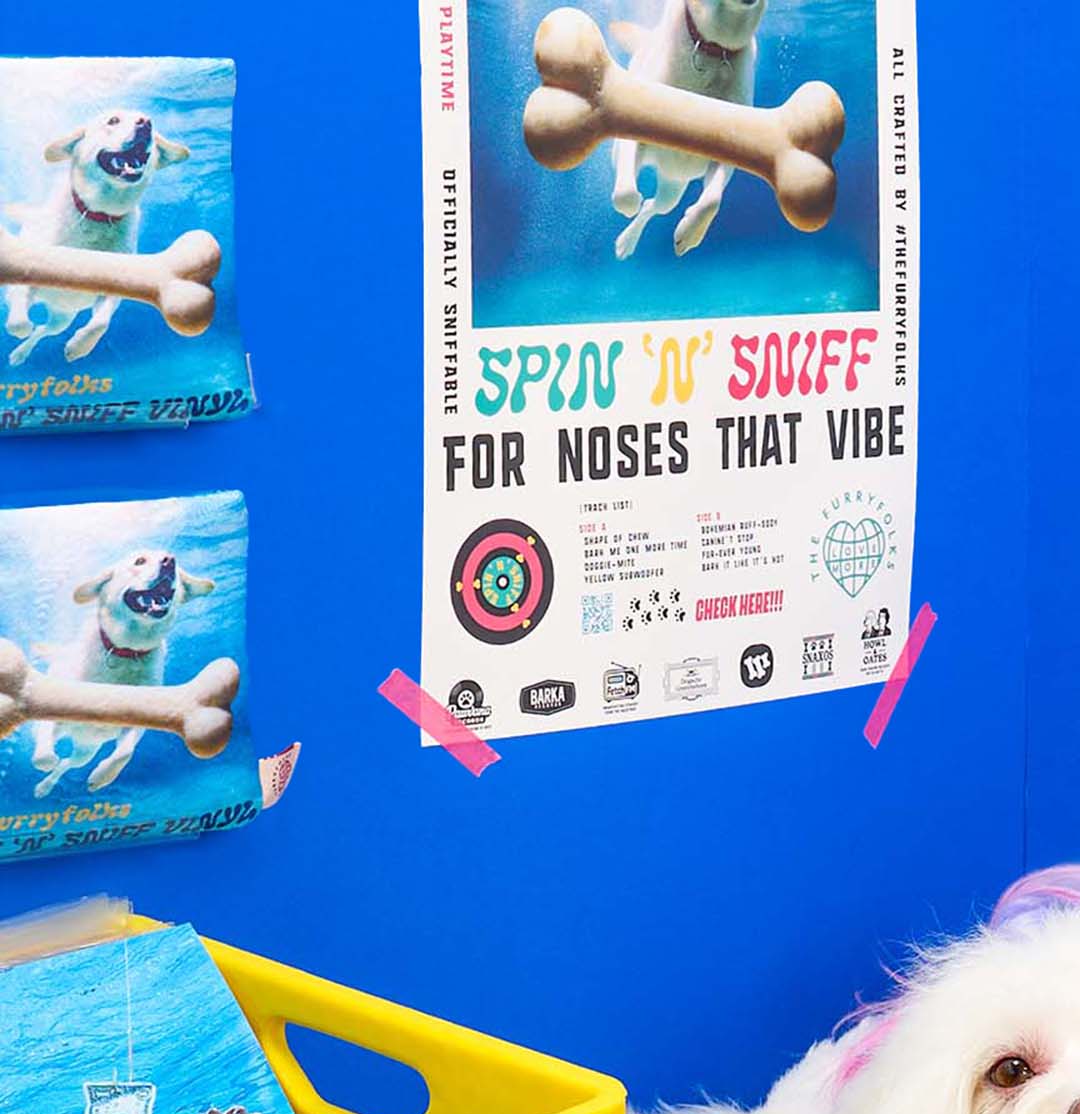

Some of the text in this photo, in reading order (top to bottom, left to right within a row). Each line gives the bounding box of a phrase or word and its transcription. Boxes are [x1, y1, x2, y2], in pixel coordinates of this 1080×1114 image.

[439, 5, 456, 113] PLAYTIME
[892, 47, 907, 388] ALL CRAFTED BY #THEFURRYFOLKS
[442, 169, 459, 417] OFFICIALLY SNIFFABLE
[474, 327, 879, 418] SPIN 'N' SNIFF
[443, 404, 906, 493] FOR NOSES THAT VIBE
[584, 531, 651, 547] SHAPE OF CHEW
[701, 523, 737, 536] BOHEMIAN
[737, 532, 755, 544] STOP
[809, 489, 899, 584] THE FURRYFOLKS
[584, 539, 689, 560] BARK ME ONE MORE TIME
[701, 544, 762, 560] FUR-EVER YOUNG
[584, 558, 636, 572] DOGGIE-MITE
[701, 561, 719, 573] BARK
[722, 560, 731, 572] IT
[733, 557, 749, 569] LIKE
[584, 567, 665, 585] YELLOW SUBWOOFER
[694, 588, 785, 623] CHECK HERE!!!
[863, 638, 888, 650] HOWL
[862, 652, 889, 666] OATES
[529, 686, 566, 706] BARKA
